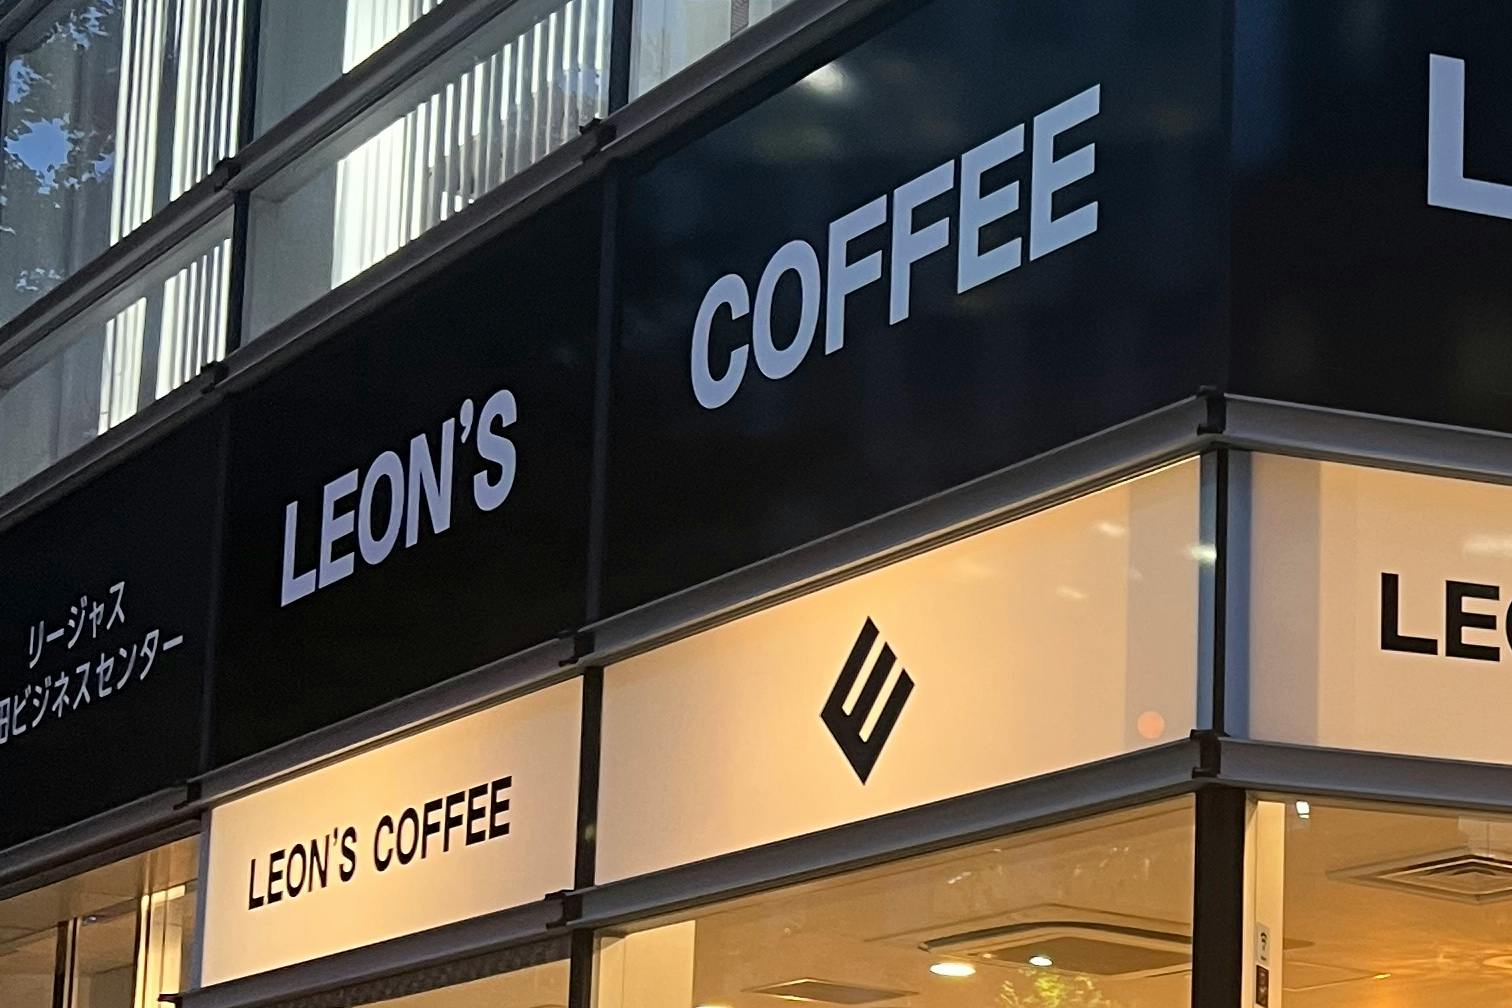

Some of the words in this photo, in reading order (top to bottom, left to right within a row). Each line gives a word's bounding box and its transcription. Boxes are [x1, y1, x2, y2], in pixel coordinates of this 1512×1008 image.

[280, 389, 517, 607] LEON'S
[691, 84, 1101, 409] COFFEE
[28, 581, 126, 669] リージャス
[248, 826, 357, 911] LEON'S
[373, 775, 513, 872] COFFEE
